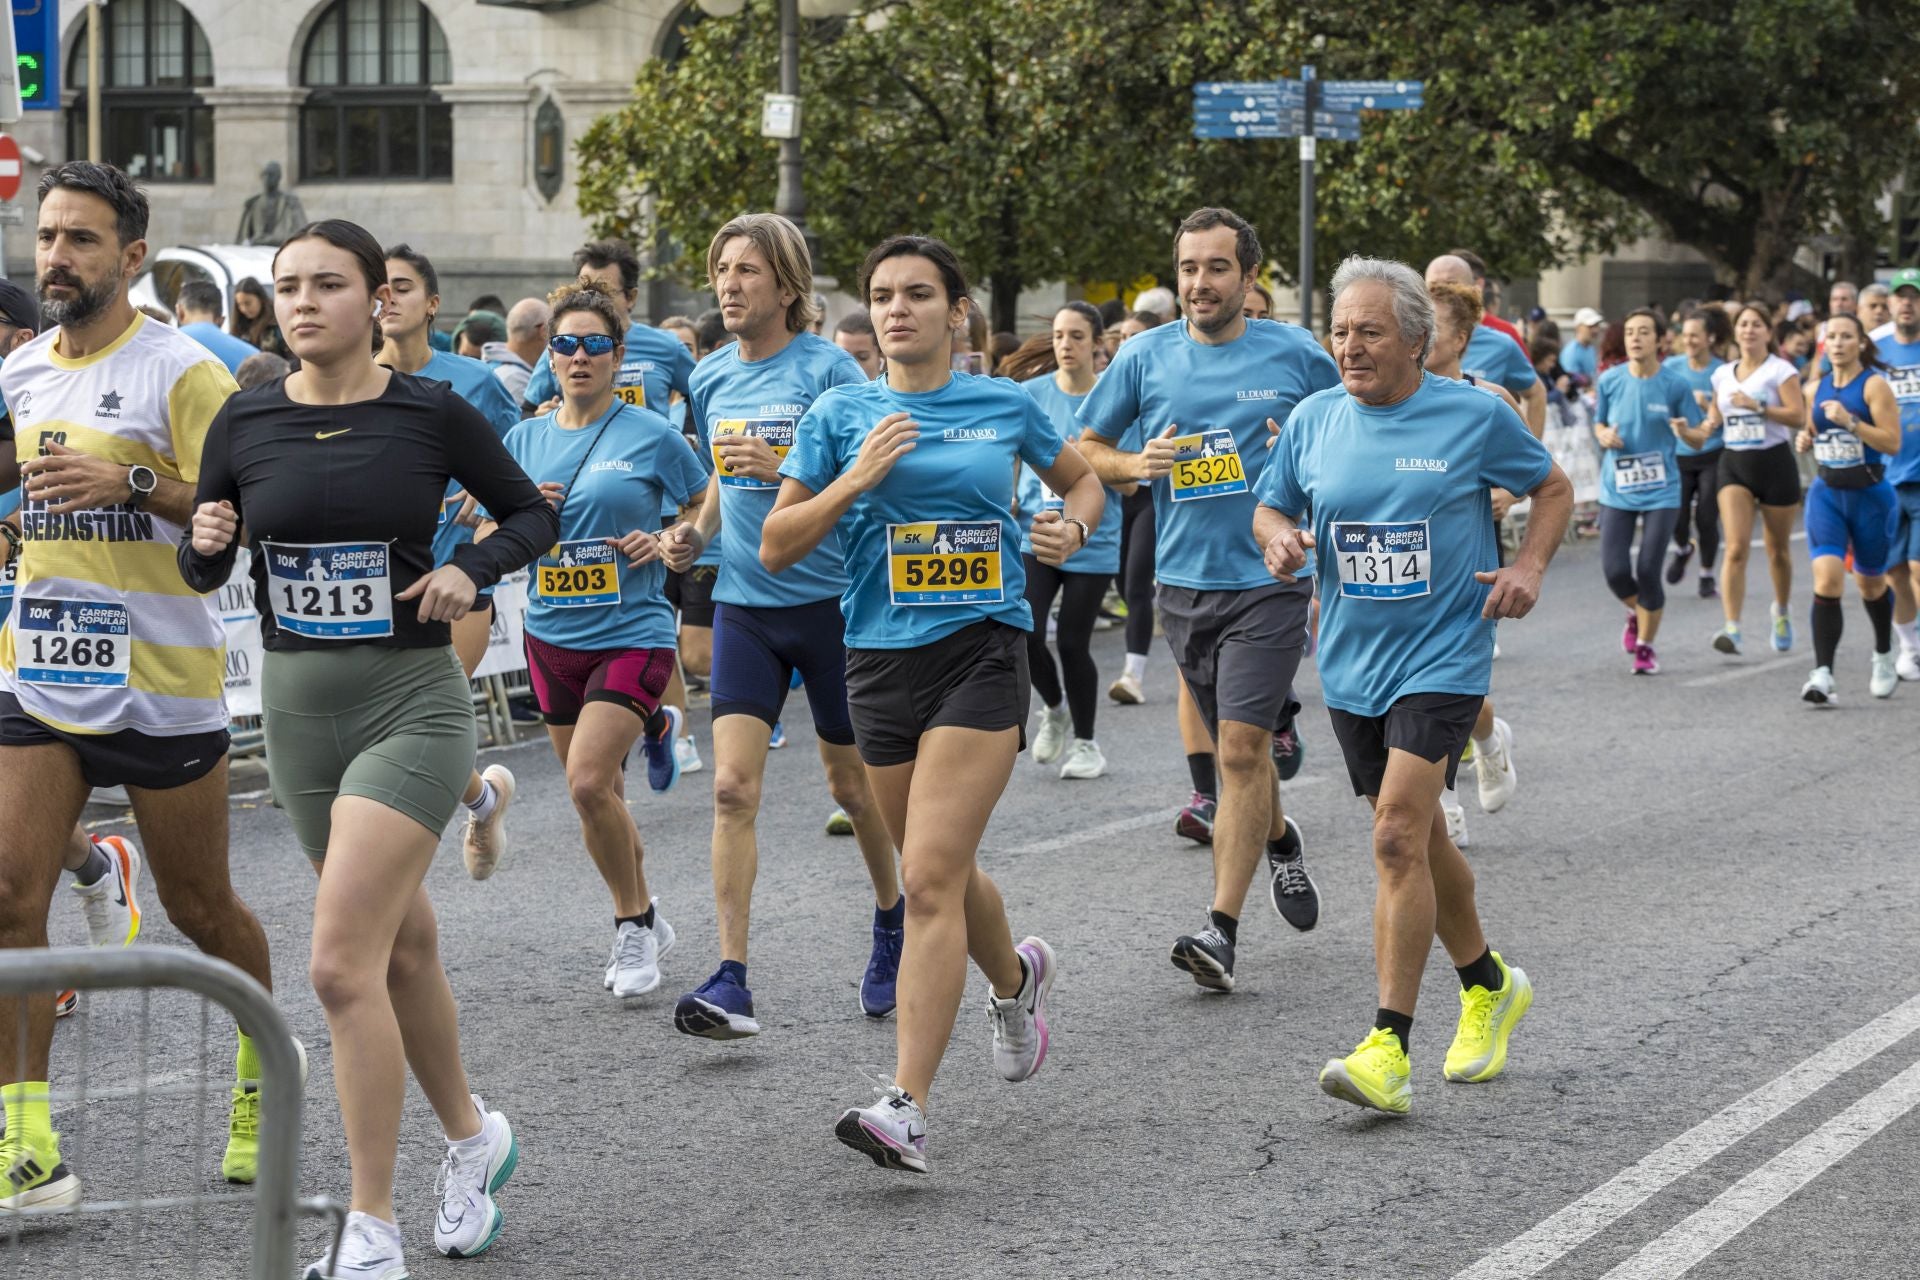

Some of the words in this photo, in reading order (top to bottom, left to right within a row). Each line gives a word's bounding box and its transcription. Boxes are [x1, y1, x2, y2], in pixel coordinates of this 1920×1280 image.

[1236, 390, 1248, 399] EL
[1249, 389, 1278, 399] DIARIO
[760, 406, 771, 414] EL
[771, 404, 803, 413] DIARIO
[723, 428, 735, 436] 5K
[756, 425, 792, 433] CARRERA
[943, 428, 958, 438] EL
[958, 428, 997, 438] DIARIO
[1179, 445, 1192, 454] 5K
[590, 462, 602, 471] EL
[602, 460, 633, 471] DIARIO
[1395, 458, 1409, 468] EL
[1410, 458, 1448, 469] DIARIO
[1180, 456, 1240, 487] 5320
[23, 512, 154, 542] SEBASTIAN
[955, 527, 998, 537] CARRERA
[903, 533, 922, 544] 5K
[1345, 533, 1365, 543] 10K
[1385, 530, 1424, 539] CARRERA
[954, 536, 997, 545] POPULAR
[1384, 536, 1424, 546] POPULAR
[576, 544, 613, 553] CARRERA
[983, 543, 996, 551] DM
[331, 550, 385, 562] CARRERA
[575, 551, 613, 560] POPULAR
[600, 556, 613, 564] DM
[277, 554, 299, 568] 10K
[330, 559, 385, 570] POPULAR
[0, 558, 18, 581] 5
[366, 567, 384, 577] DM
[906, 557, 989, 586] 5296
[1346, 554, 1421, 583] 1314
[544, 567, 607, 592] 5203
[283, 584, 374, 616] 1213
[29, 607, 53, 620] 10K
[79, 608, 127, 618] CARRERA
[77, 615, 127, 626] POPULAR
[109, 625, 126, 633] DM
[32, 634, 115, 667] 1268
